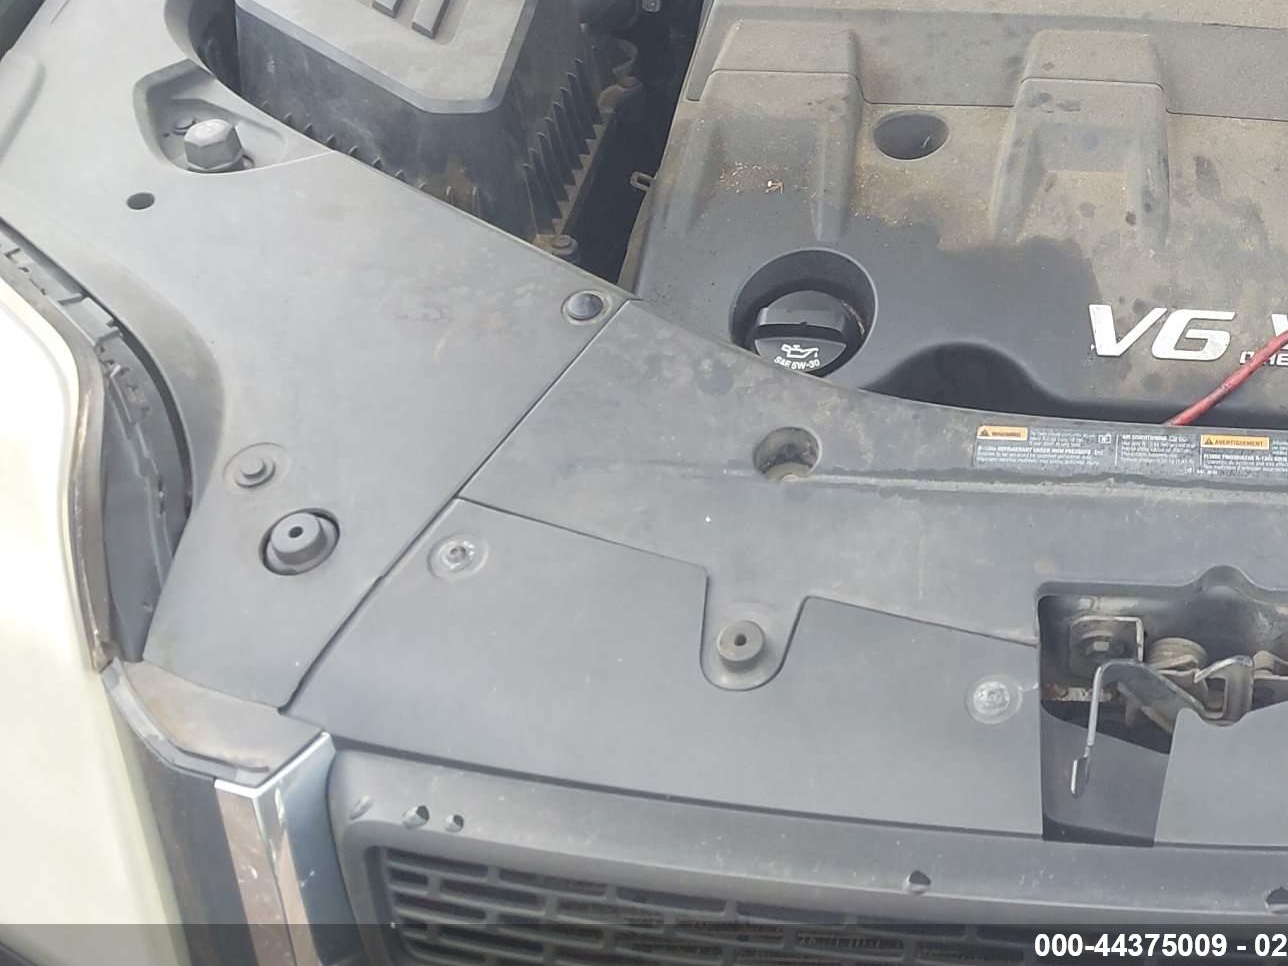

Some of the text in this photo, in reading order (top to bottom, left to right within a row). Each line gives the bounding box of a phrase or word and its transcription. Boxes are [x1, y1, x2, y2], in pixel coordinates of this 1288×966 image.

[1088, 304, 1236, 361] V6
[774, 356, 820, 370] SAE 5W-30
